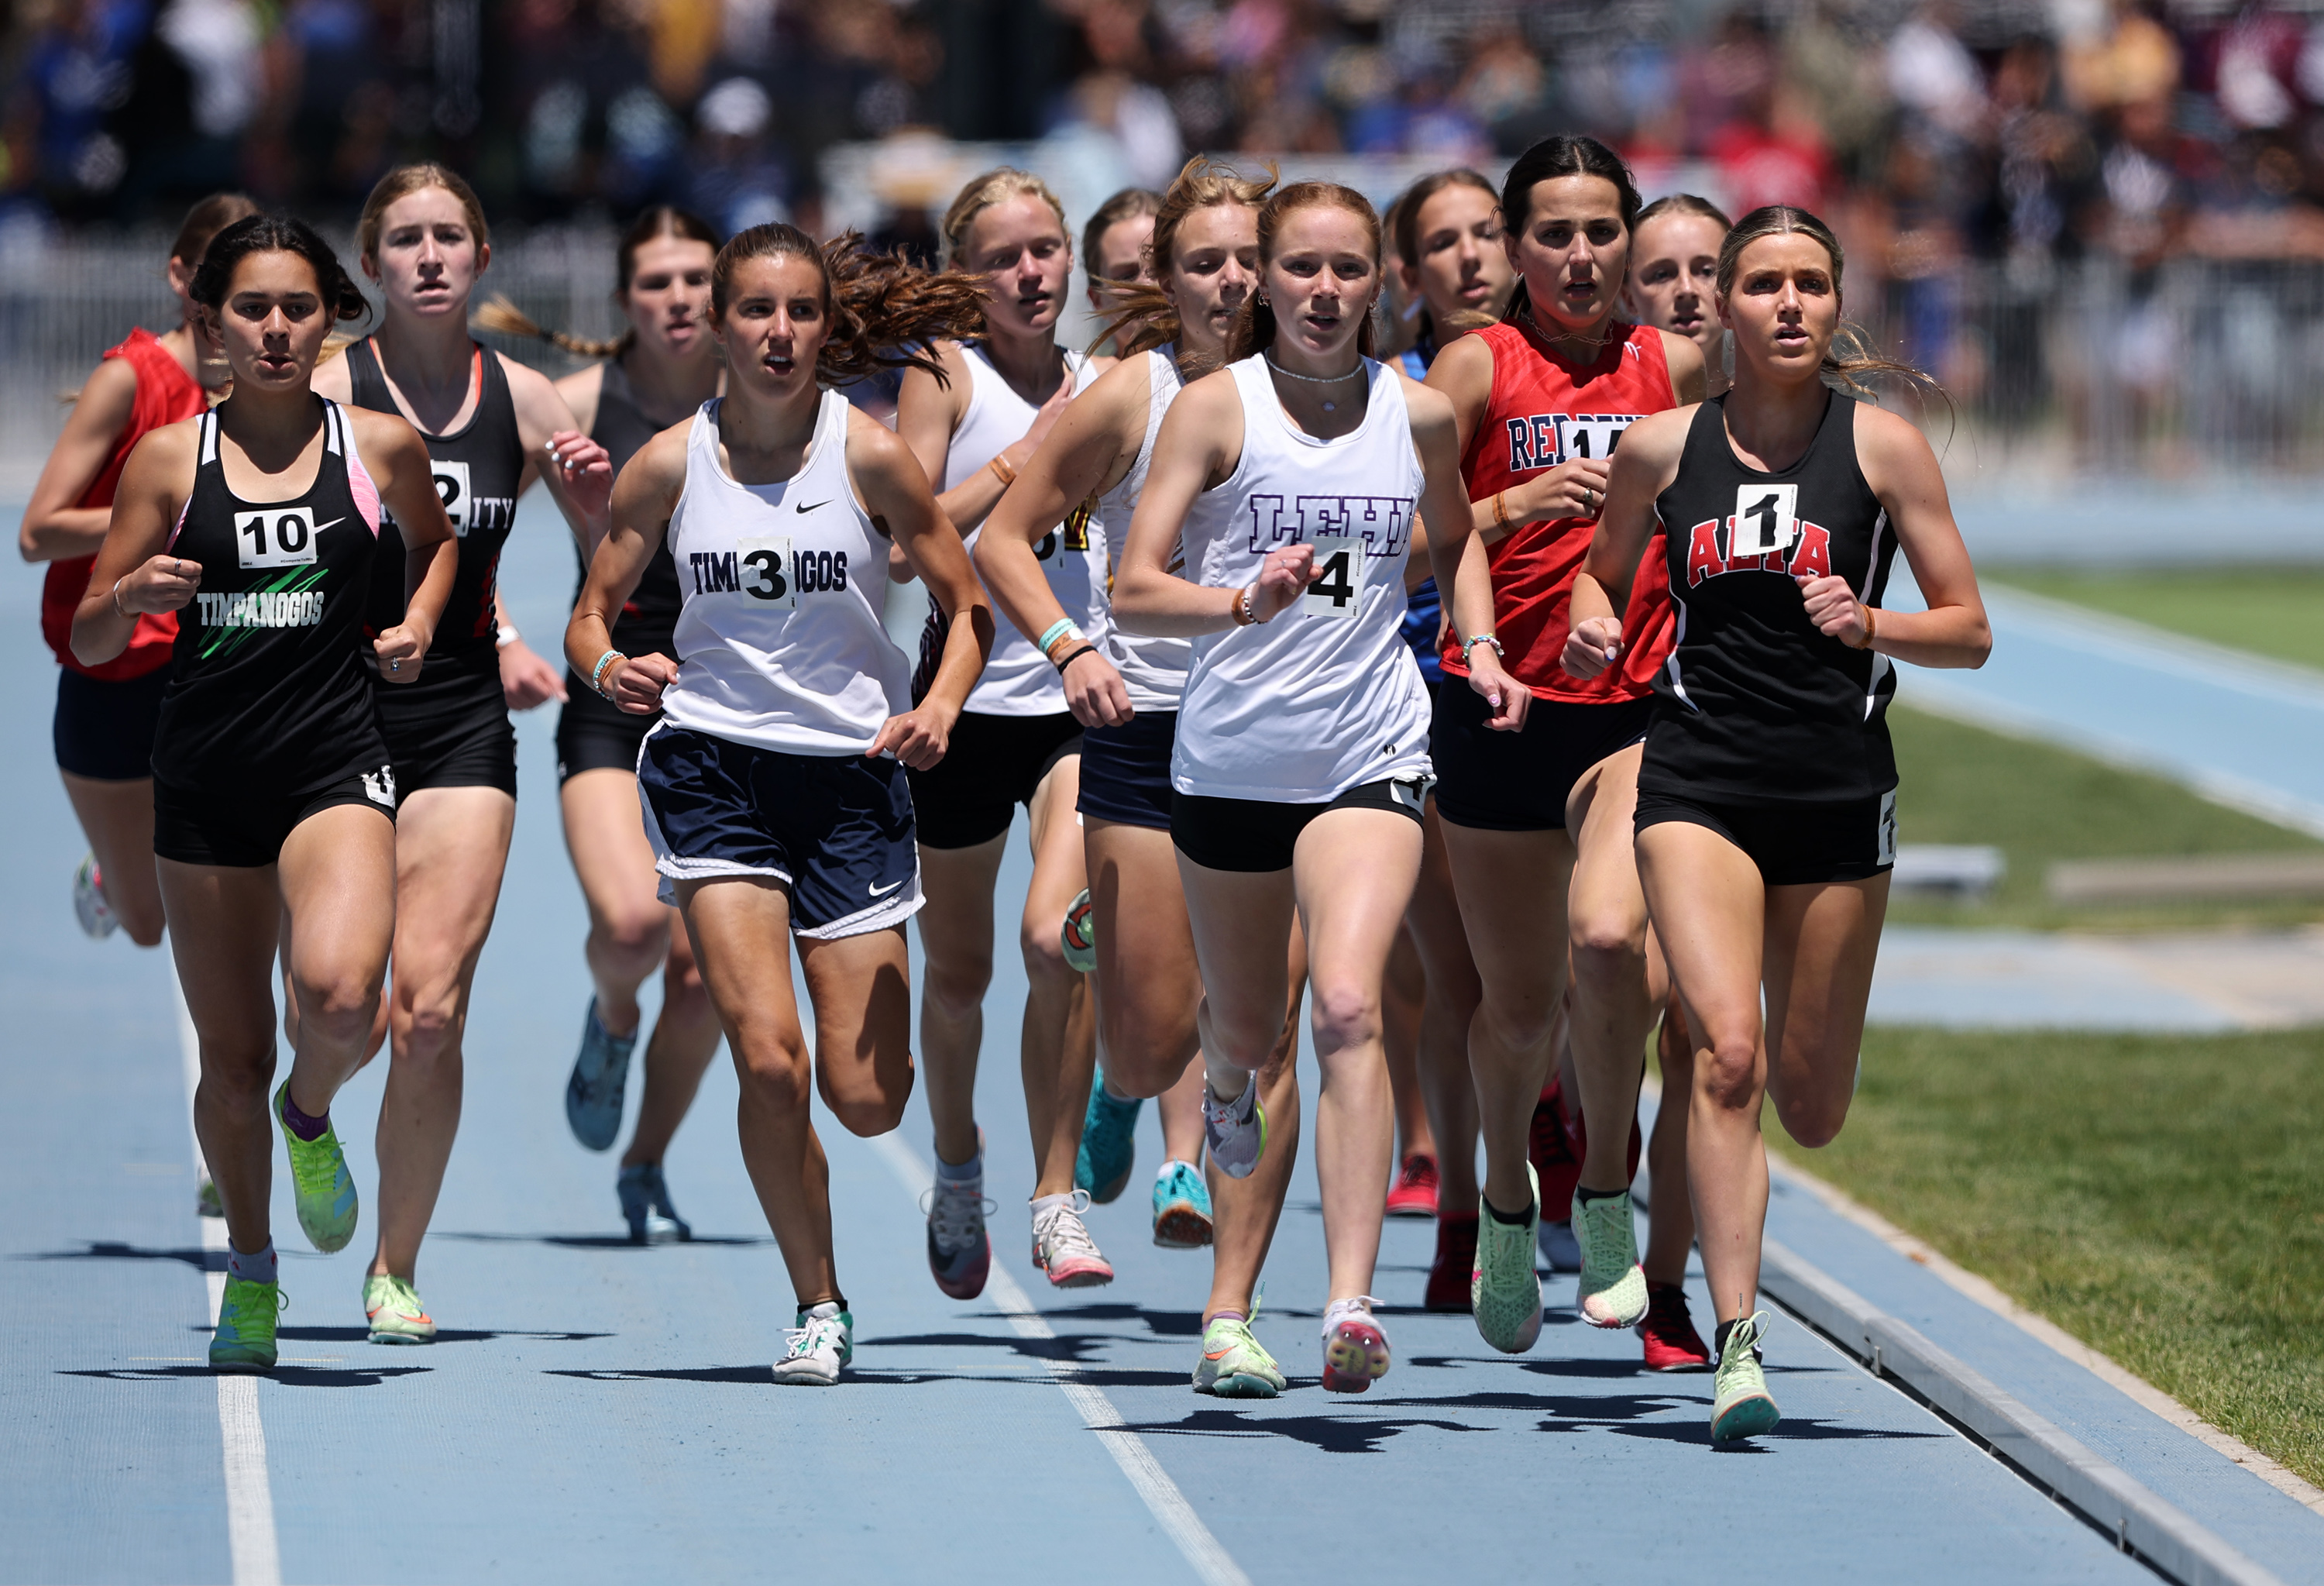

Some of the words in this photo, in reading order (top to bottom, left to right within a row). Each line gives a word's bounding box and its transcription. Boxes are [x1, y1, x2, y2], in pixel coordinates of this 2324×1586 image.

[432, 474, 460, 525] 2
[471, 497, 513, 529] ITY
[1745, 494, 1779, 548] 1
[243, 514, 308, 555] 10
[1250, 494, 1413, 556] LEHI
[690, 550, 847, 594] TIMGOS
[744, 550, 786, 600] 3
[1307, 552, 1353, 607] 4
[197, 591, 324, 628] TIMPANOGOS
